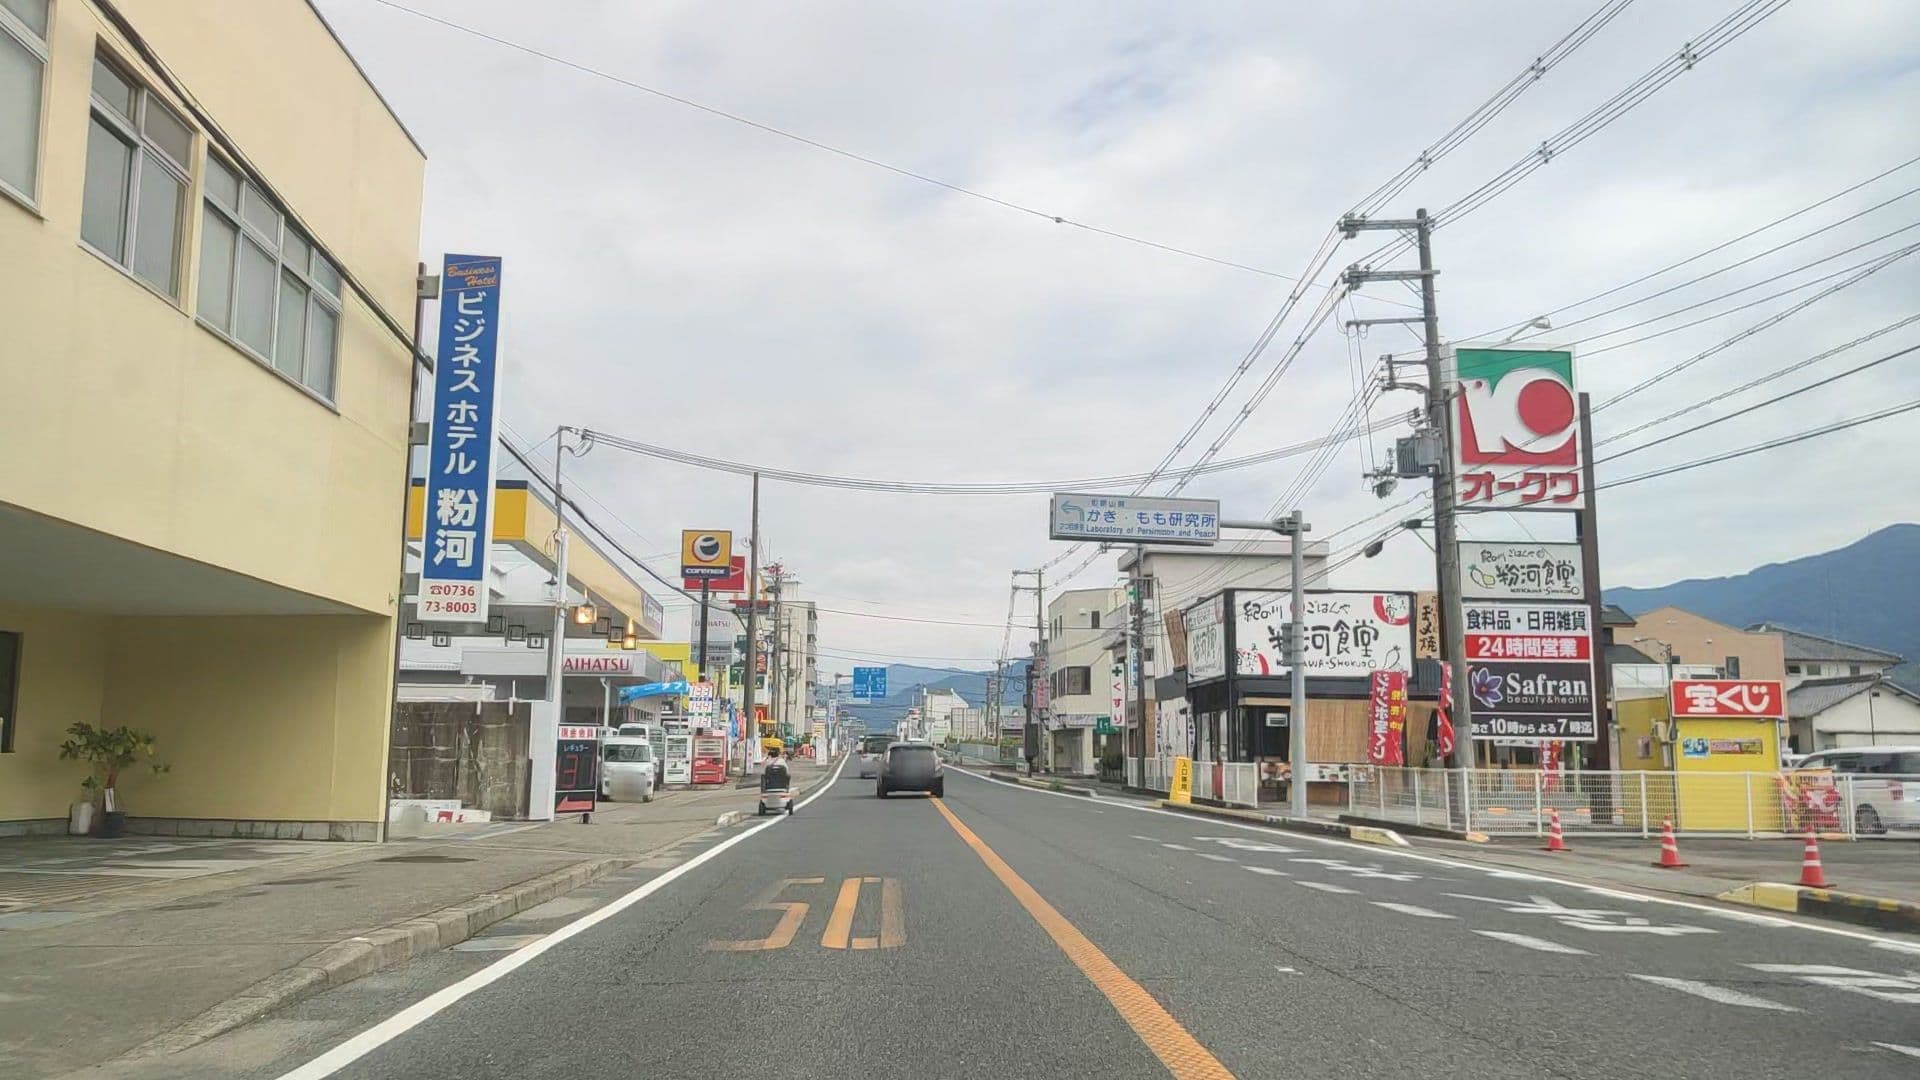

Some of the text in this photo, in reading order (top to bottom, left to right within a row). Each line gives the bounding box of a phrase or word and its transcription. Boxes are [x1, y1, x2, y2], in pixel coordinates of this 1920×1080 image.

[447, 265, 495, 277] Business
[465, 275, 497, 287] Hotel
[1462, 471, 1579, 501] オークワ
[433, 488, 478, 567] 粉河
[1086, 525, 1123, 535] Laboratory
[1138, 527, 1175, 537] Persimmon
[1179, 528, 1191, 537] and
[1194, 530, 1216, 538] Peach
[1495, 559, 1575, 589] 粉河食堂
[444, 584, 475, 597] 0736
[425, 601, 477, 614] 73-8003
[1243, 600, 1283, 622] 紀の川
[1466, 609, 1587, 631] 食料品・日用雑貨
[1478, 636, 1578, 658] 24時間営業
[562, 657, 630, 672] AIHATSU
[1506, 672, 1588, 696] Safran
[1112, 681, 1123, 725] くすり
[1506, 694, 1589, 704] beauty&health
[1684, 684, 1770, 714] 宝くじ
[708, 875, 906, 951] 50
